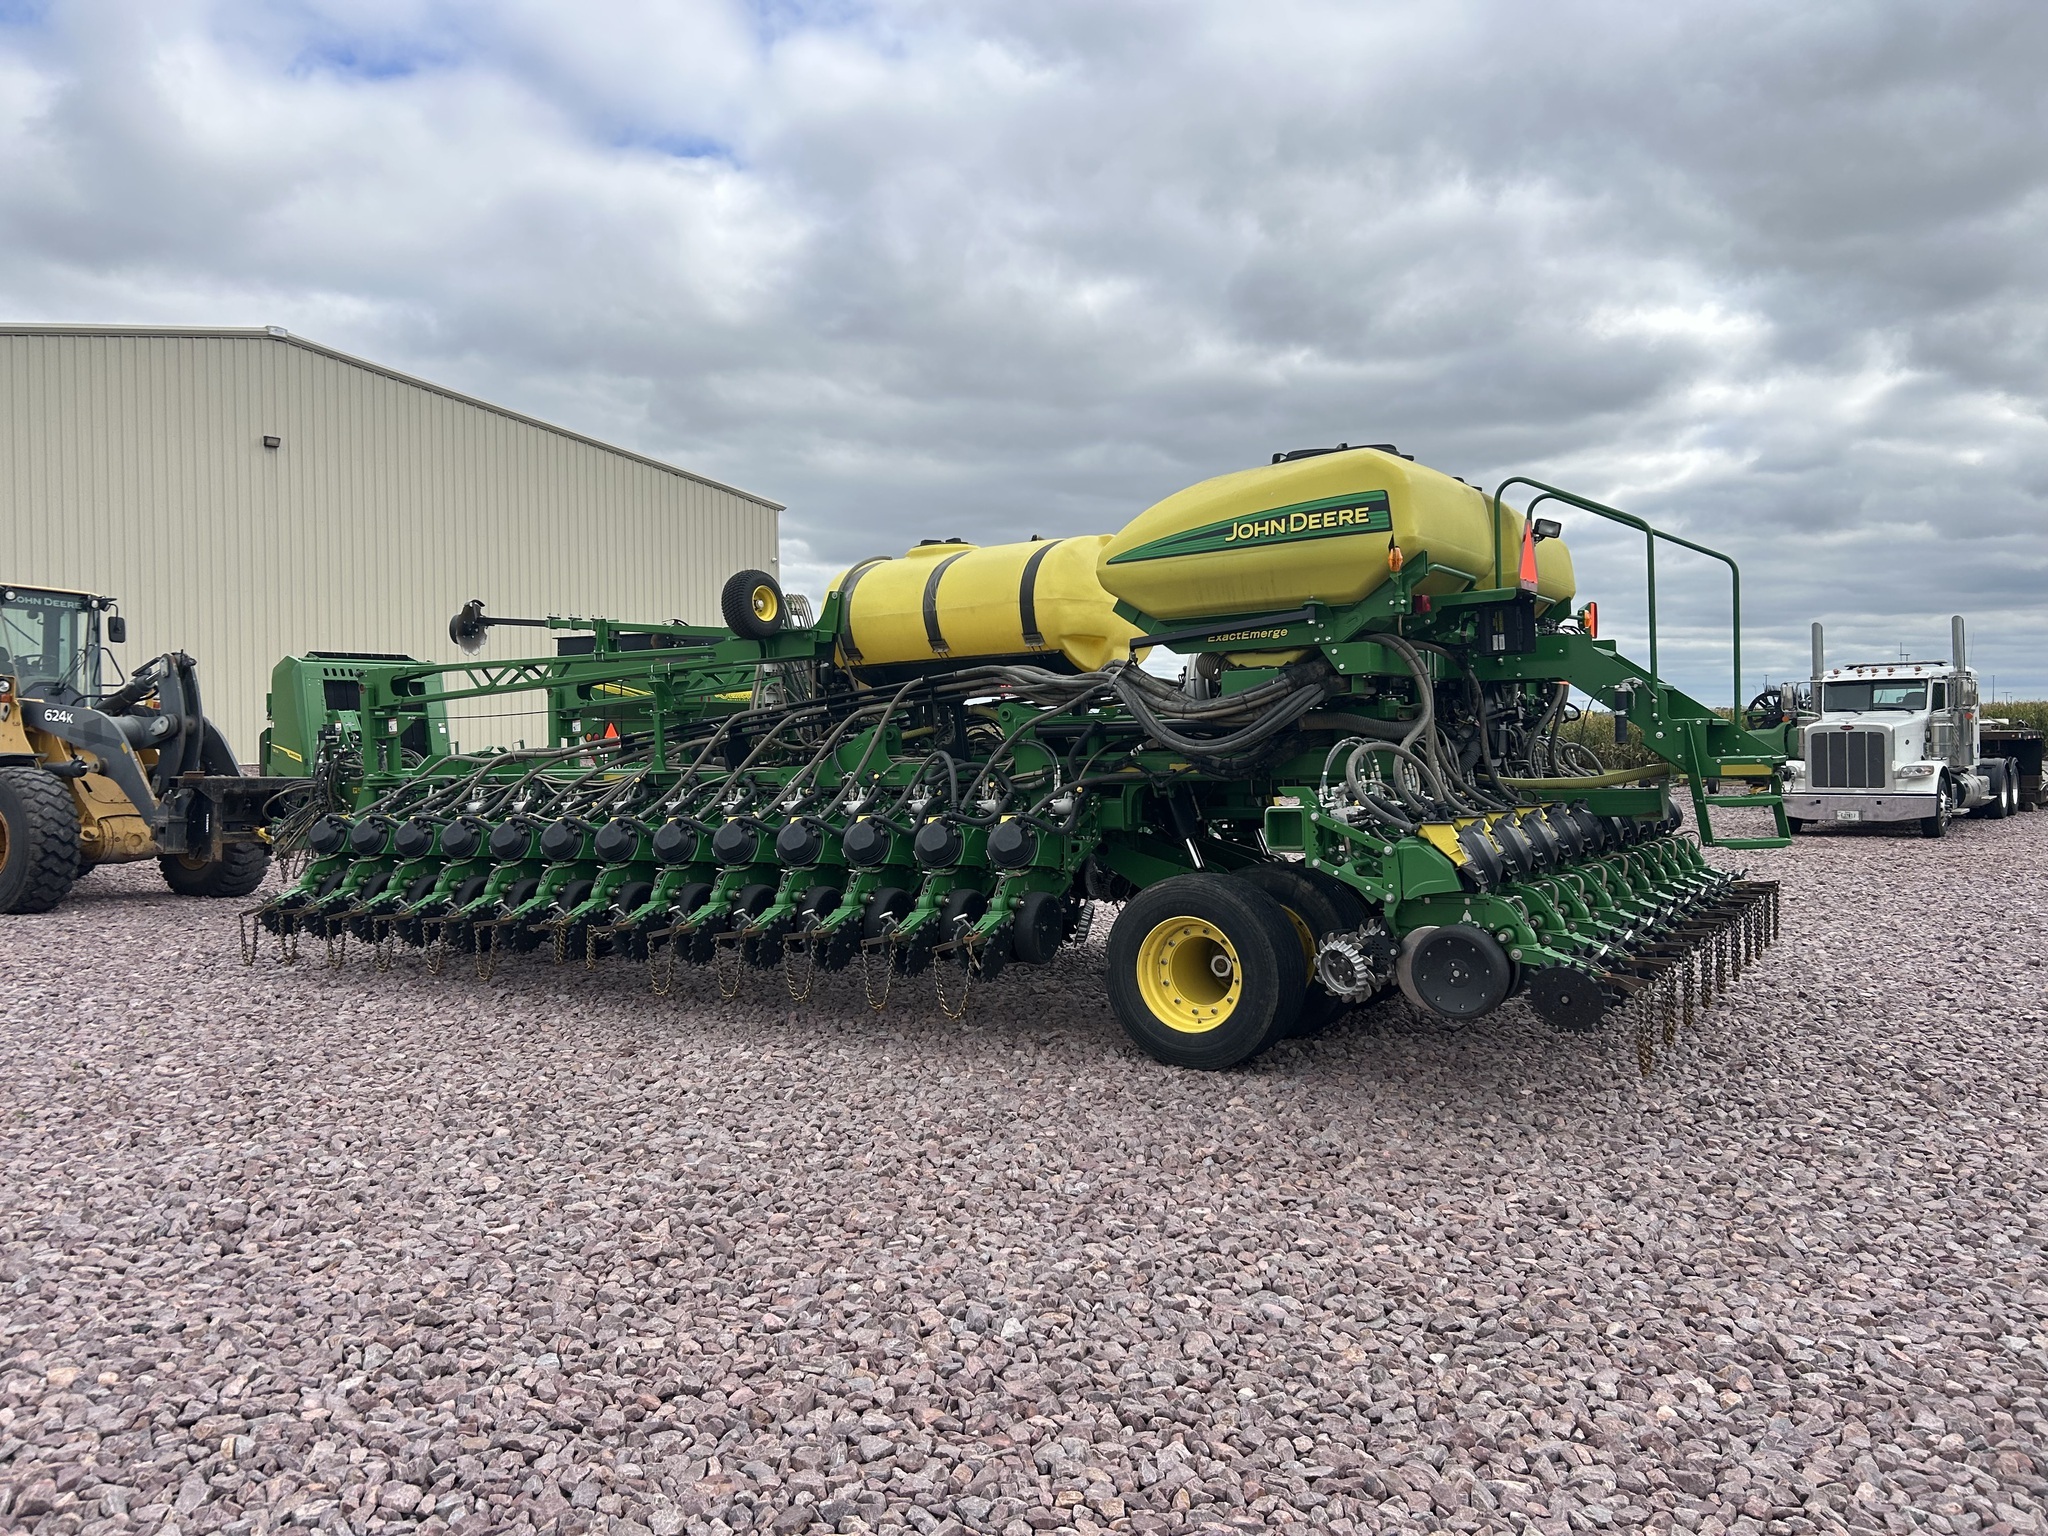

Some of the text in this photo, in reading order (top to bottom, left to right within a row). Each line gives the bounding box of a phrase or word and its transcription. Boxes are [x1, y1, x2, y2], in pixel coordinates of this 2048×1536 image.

[1225, 507, 1369, 542] JOHN DEERE
[44, 597, 82, 609] DEERE
[44, 709, 73, 724] 624K
